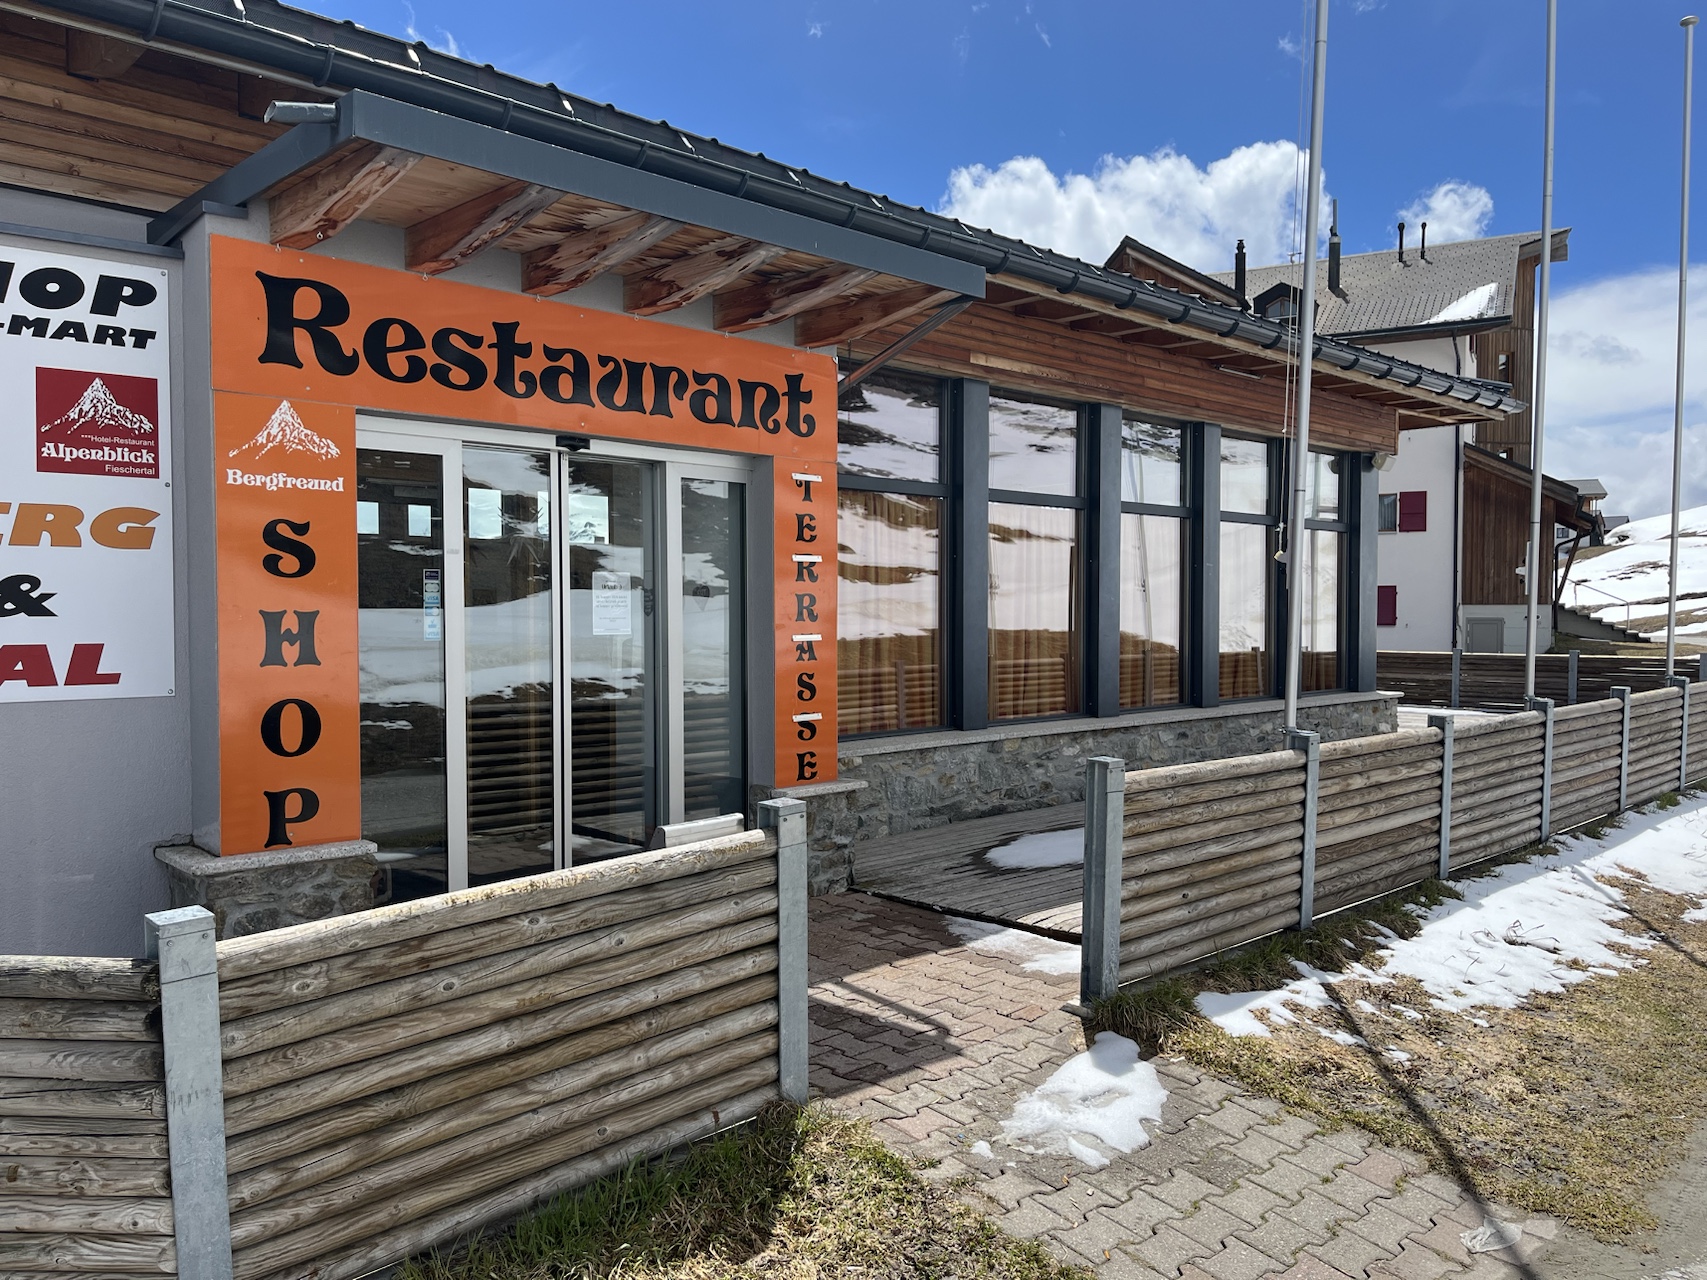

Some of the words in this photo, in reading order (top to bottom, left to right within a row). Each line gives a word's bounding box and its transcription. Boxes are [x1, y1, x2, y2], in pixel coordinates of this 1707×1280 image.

[0, 262, 158, 316] OP
[255, 270, 816, 437] Restaurant
[41, 442, 155, 463] Alpenblick
[105, 464, 155, 475] Fieschertal
[226, 469, 345, 492] Bergfreund
[0, 502, 161, 550] RG
[795, 472, 819, 782] TERRASSE
[258, 518, 322, 849] SHOP
